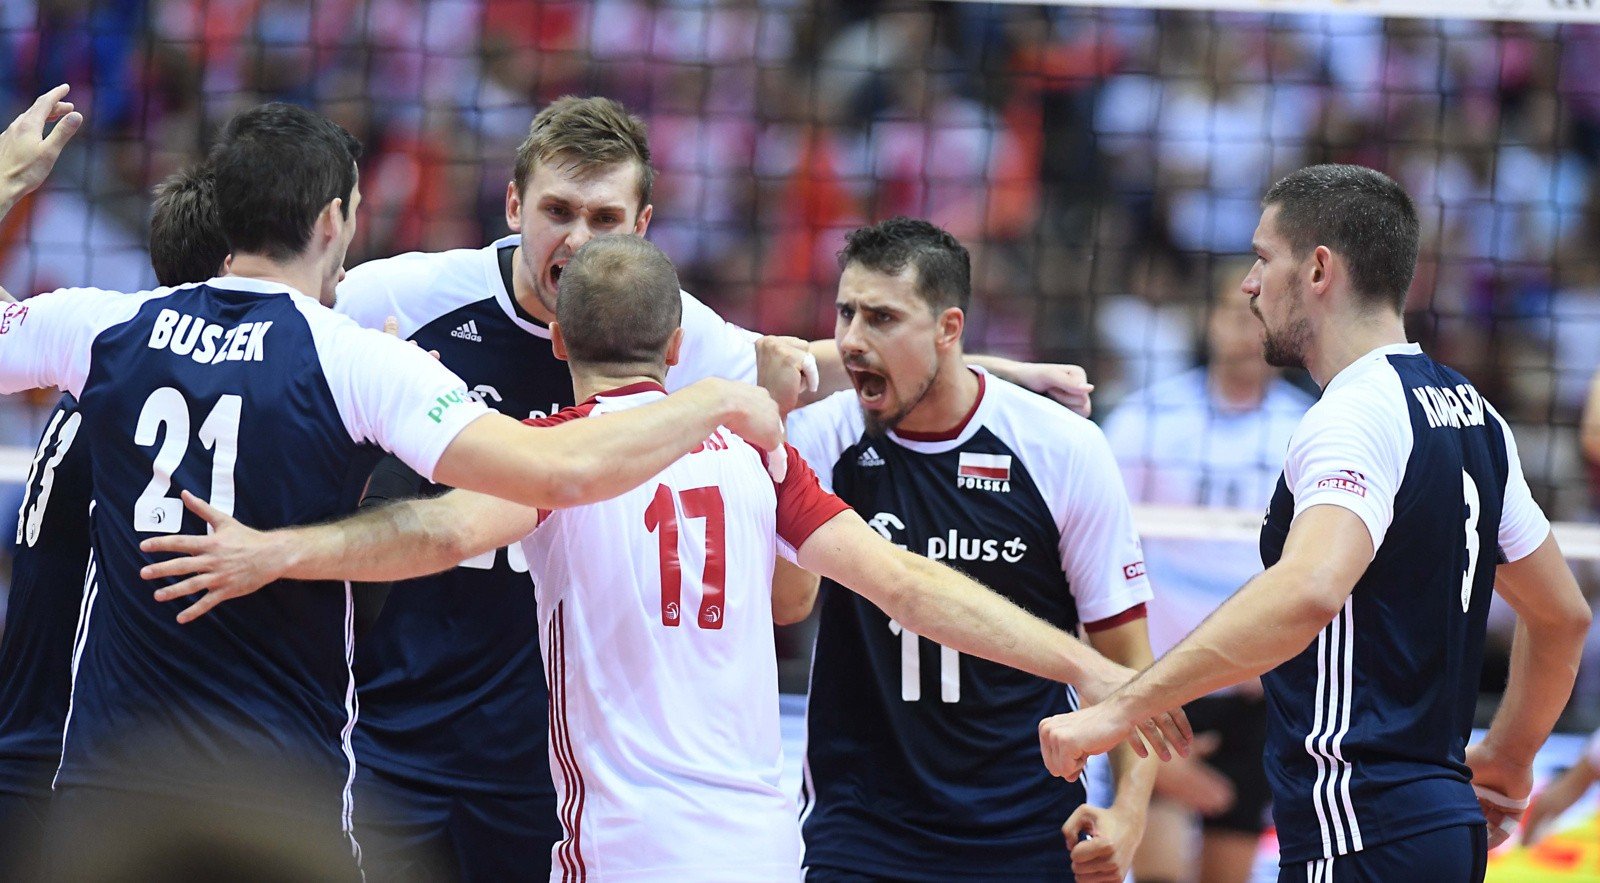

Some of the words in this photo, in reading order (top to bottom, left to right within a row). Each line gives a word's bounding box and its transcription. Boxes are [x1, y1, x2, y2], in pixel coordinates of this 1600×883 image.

[148, 309, 273, 364] BUSZEK
[451, 329, 482, 342] adidas
[134, 387, 242, 534] 21
[957, 477, 1011, 492] POLSKA
[1319, 479, 1364, 497] ORLEN
[644, 483, 726, 629] 17
[1461, 467, 1480, 613] 3
